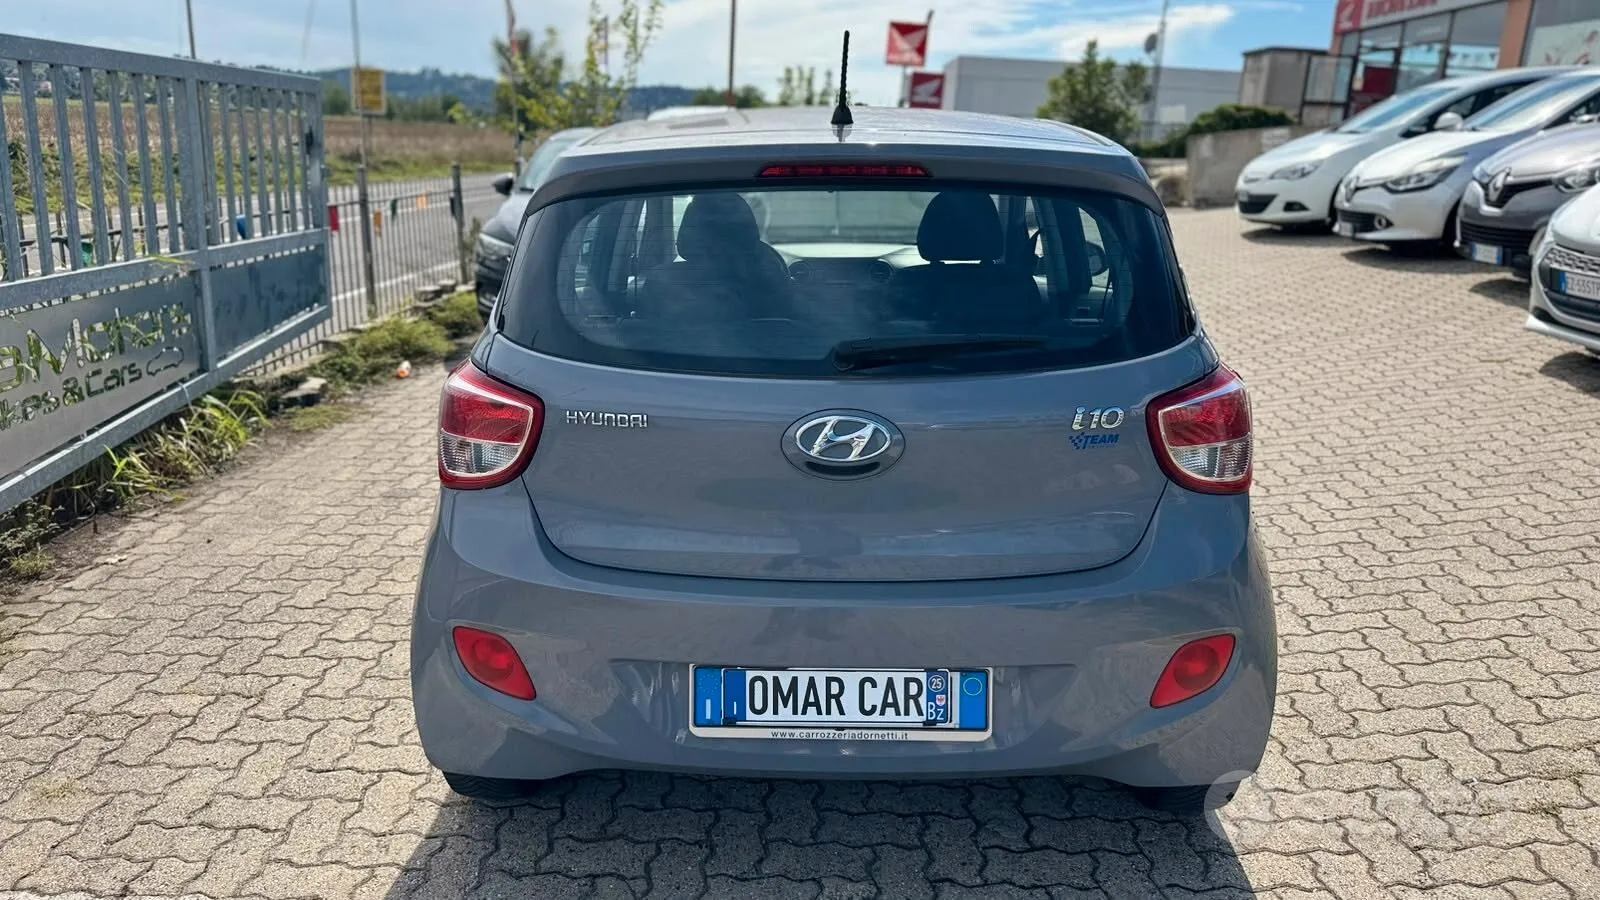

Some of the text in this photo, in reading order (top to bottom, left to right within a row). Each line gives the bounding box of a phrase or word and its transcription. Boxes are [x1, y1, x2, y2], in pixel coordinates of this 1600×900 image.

[566, 410, 648, 428] HYUNDAI
[1071, 406, 1125, 430] i10
[931, 677, 942, 689] 25
[748, 675, 924, 717] OMAR CAR
[770, 730, 908, 740] www.carrozzeriadornetti.it
